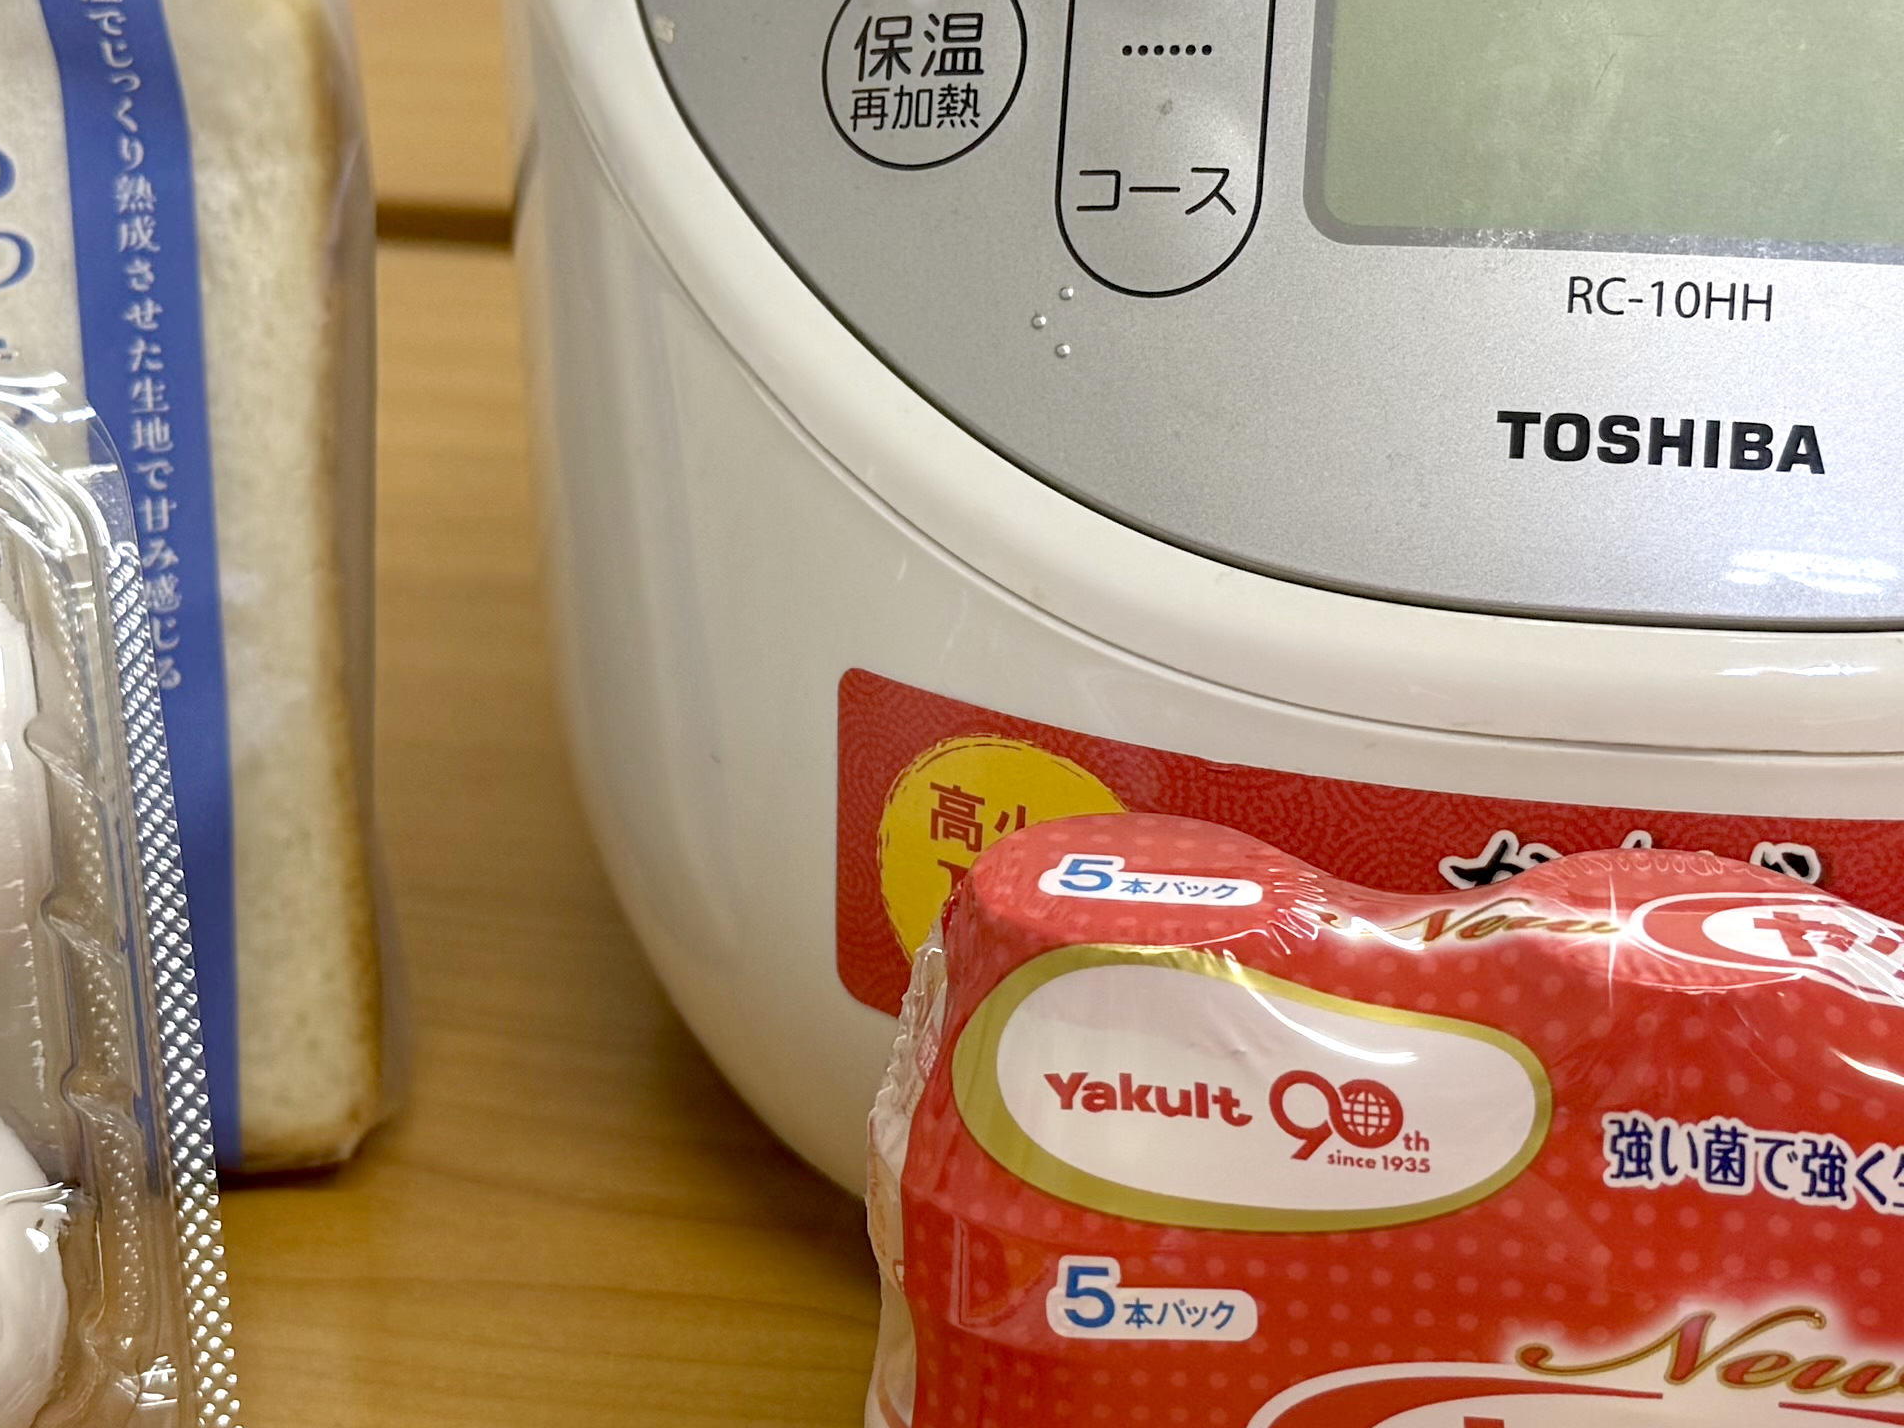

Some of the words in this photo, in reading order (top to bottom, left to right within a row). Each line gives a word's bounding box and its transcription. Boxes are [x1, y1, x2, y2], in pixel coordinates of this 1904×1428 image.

[854, 12, 985, 81] 保温
[851, 83, 981, 132] 再加熱
[1075, 167, 1237, 217] コース
[1567, 275, 1773, 322] RC-10HH
[1496, 410, 1826, 475] TOSHIBA
[1062, 857, 1241, 902] 5本パック
[1043, 1071, 1253, 1128] Yakult
[1327, 1150, 1377, 1172] since
[1381, 1155, 1431, 1175] 1935
[1064, 1264, 1237, 1333] 5本パック
